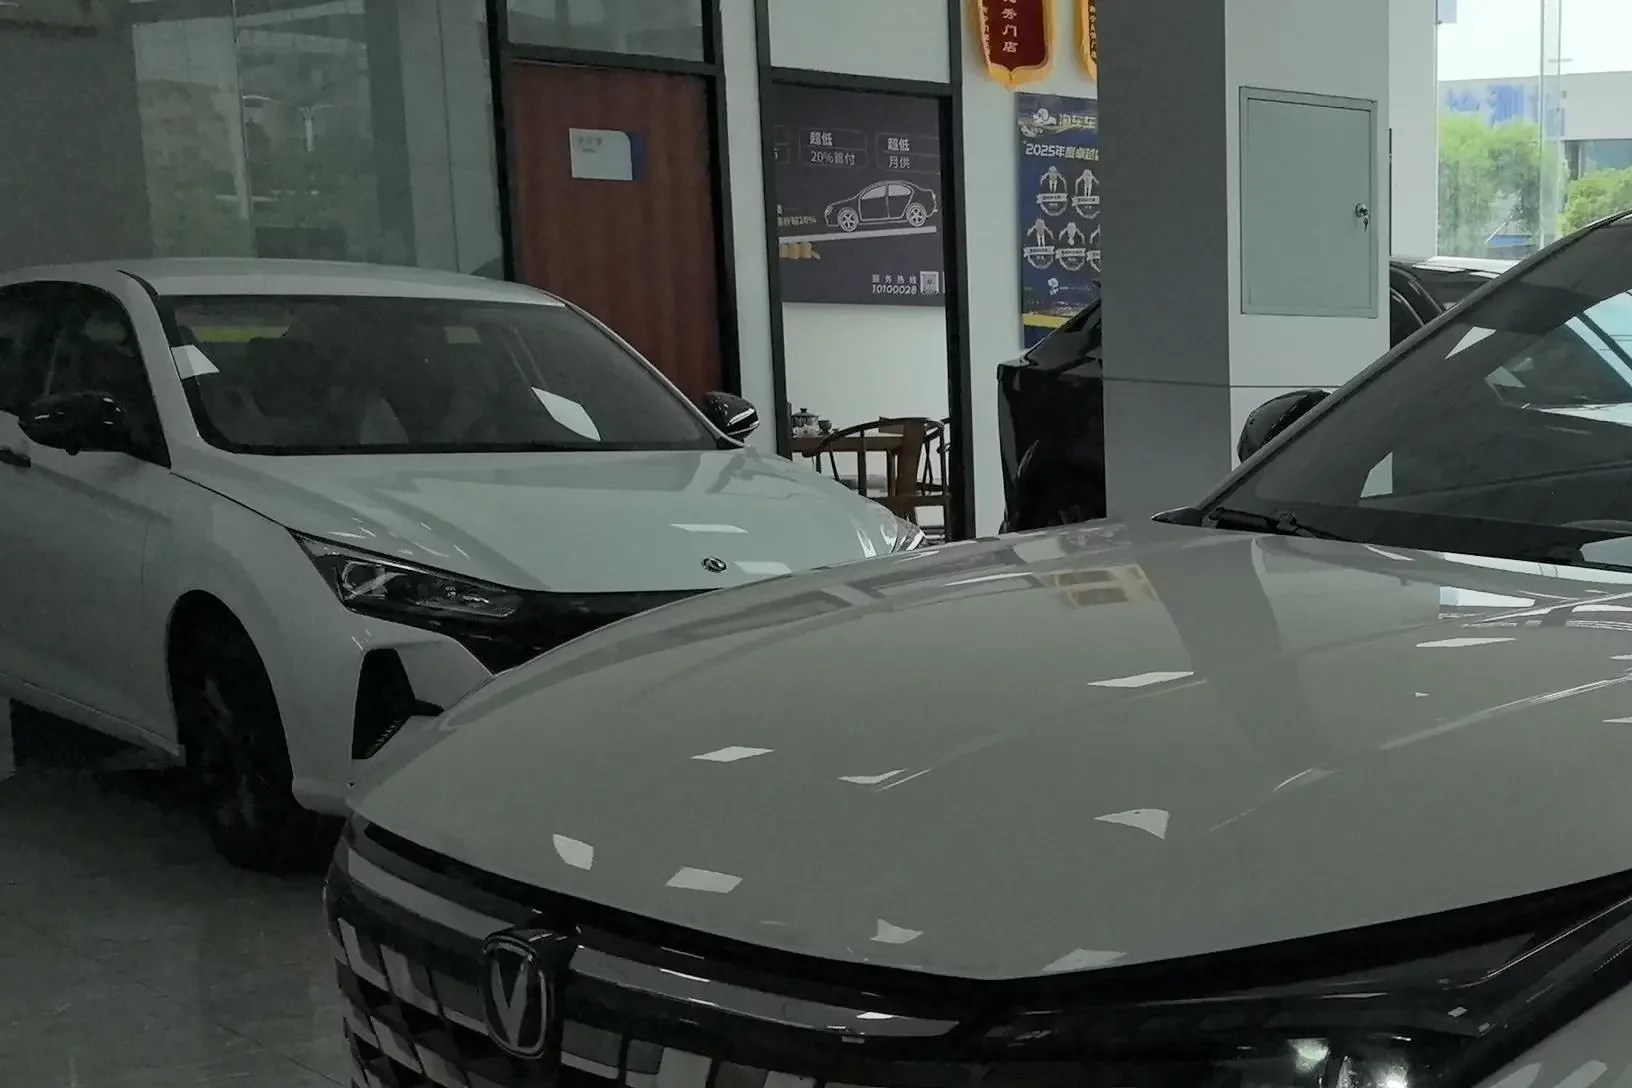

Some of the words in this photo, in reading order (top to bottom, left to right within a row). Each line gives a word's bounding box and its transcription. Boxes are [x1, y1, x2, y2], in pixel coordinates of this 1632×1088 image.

[1000, 0, 1019, 53] 秀门店
[809, 131, 833, 147] 超低
[887, 137, 911, 152] 超低
[888, 155, 911, 169] 月供
[872, 283, 917, 295] 10100028
